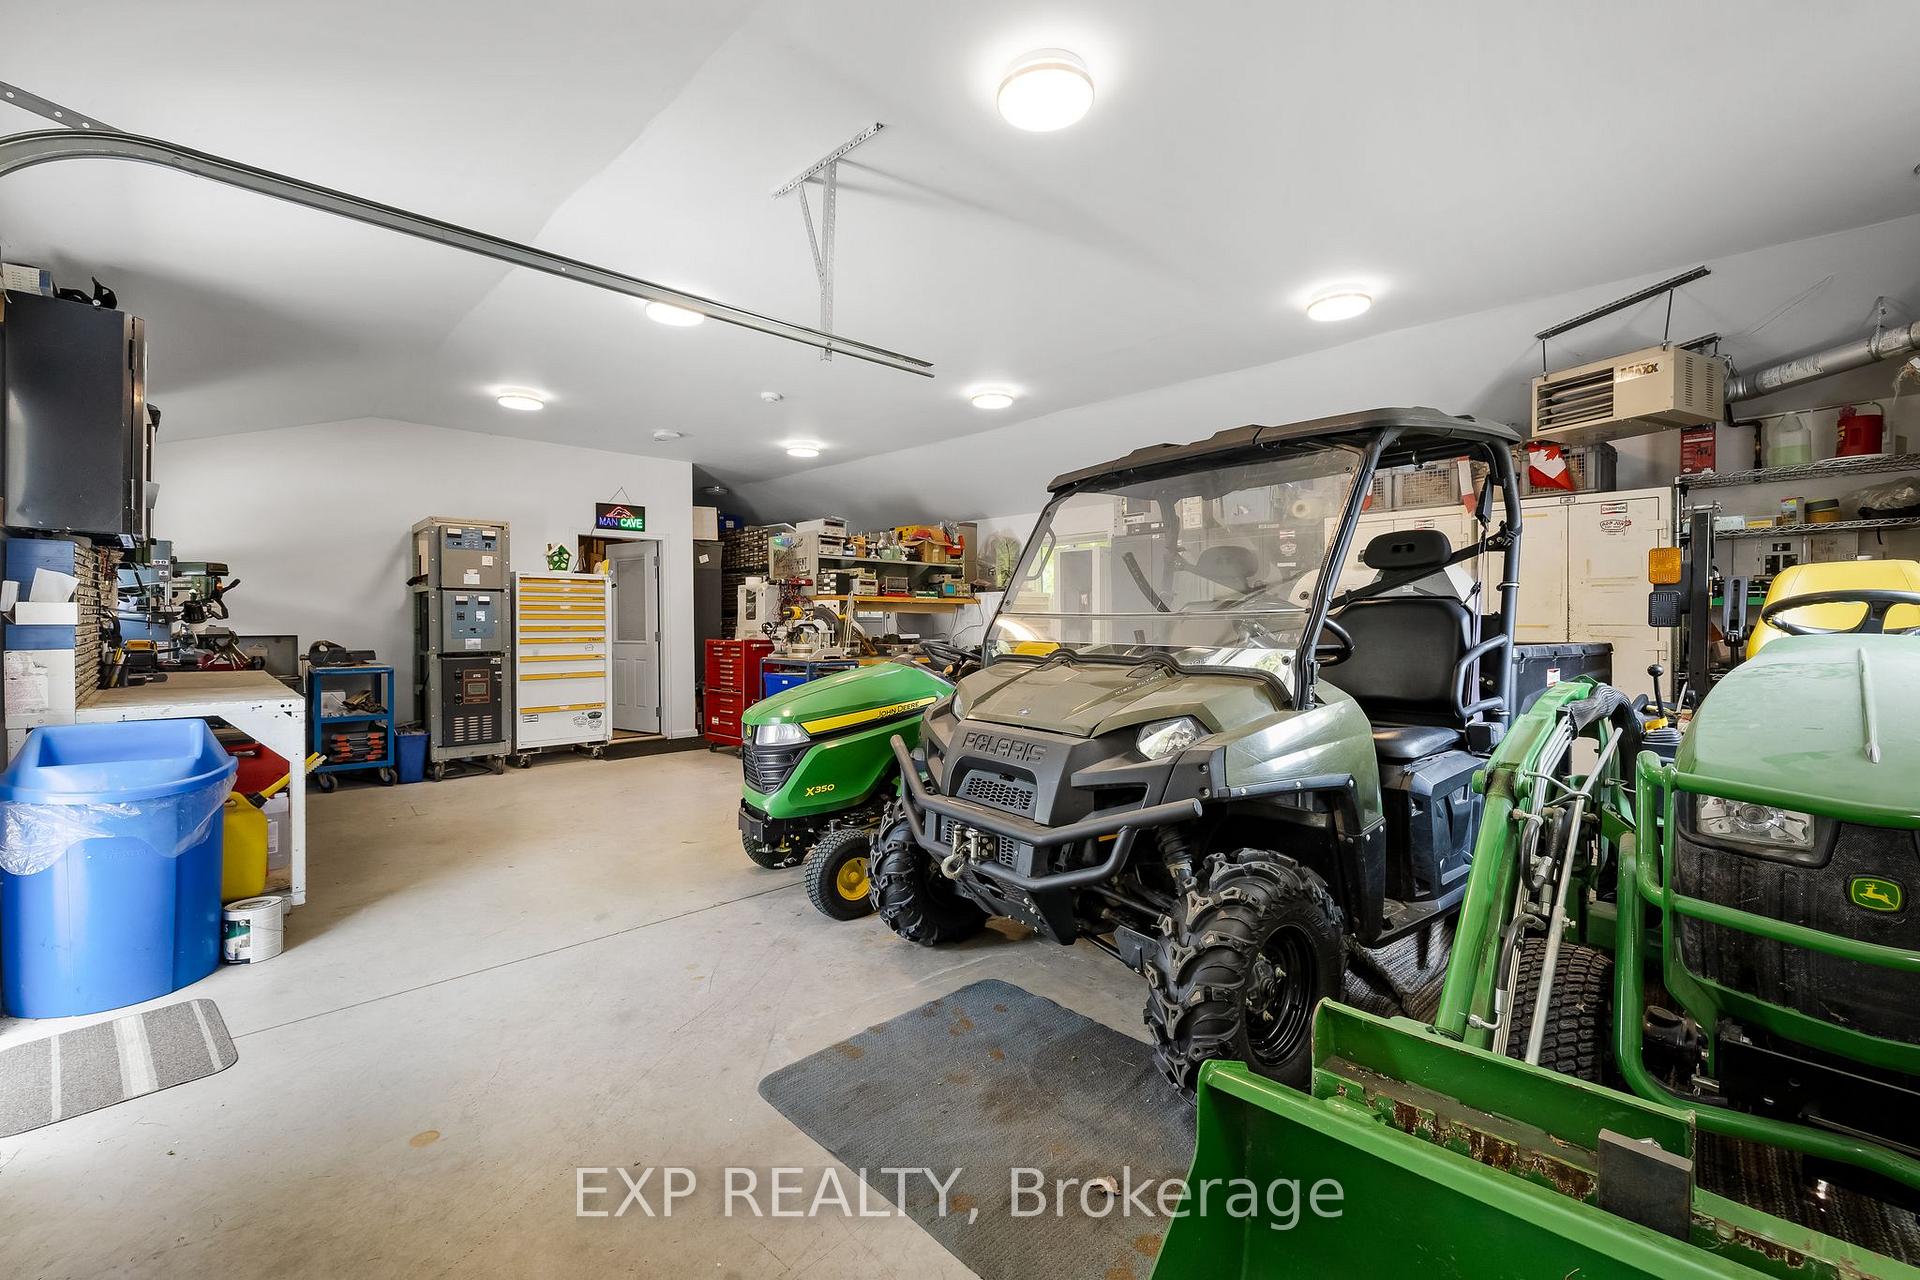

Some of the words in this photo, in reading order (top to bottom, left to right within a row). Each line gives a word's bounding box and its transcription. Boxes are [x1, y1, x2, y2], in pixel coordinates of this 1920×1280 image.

[599, 516, 618, 526] MAN
[620, 517, 643, 529] CAVE
[876, 706, 897, 718] JOHN
[897, 701, 920, 713] DEERE
[962, 731, 1048, 762] POLARIS
[804, 783, 835, 797] X350
